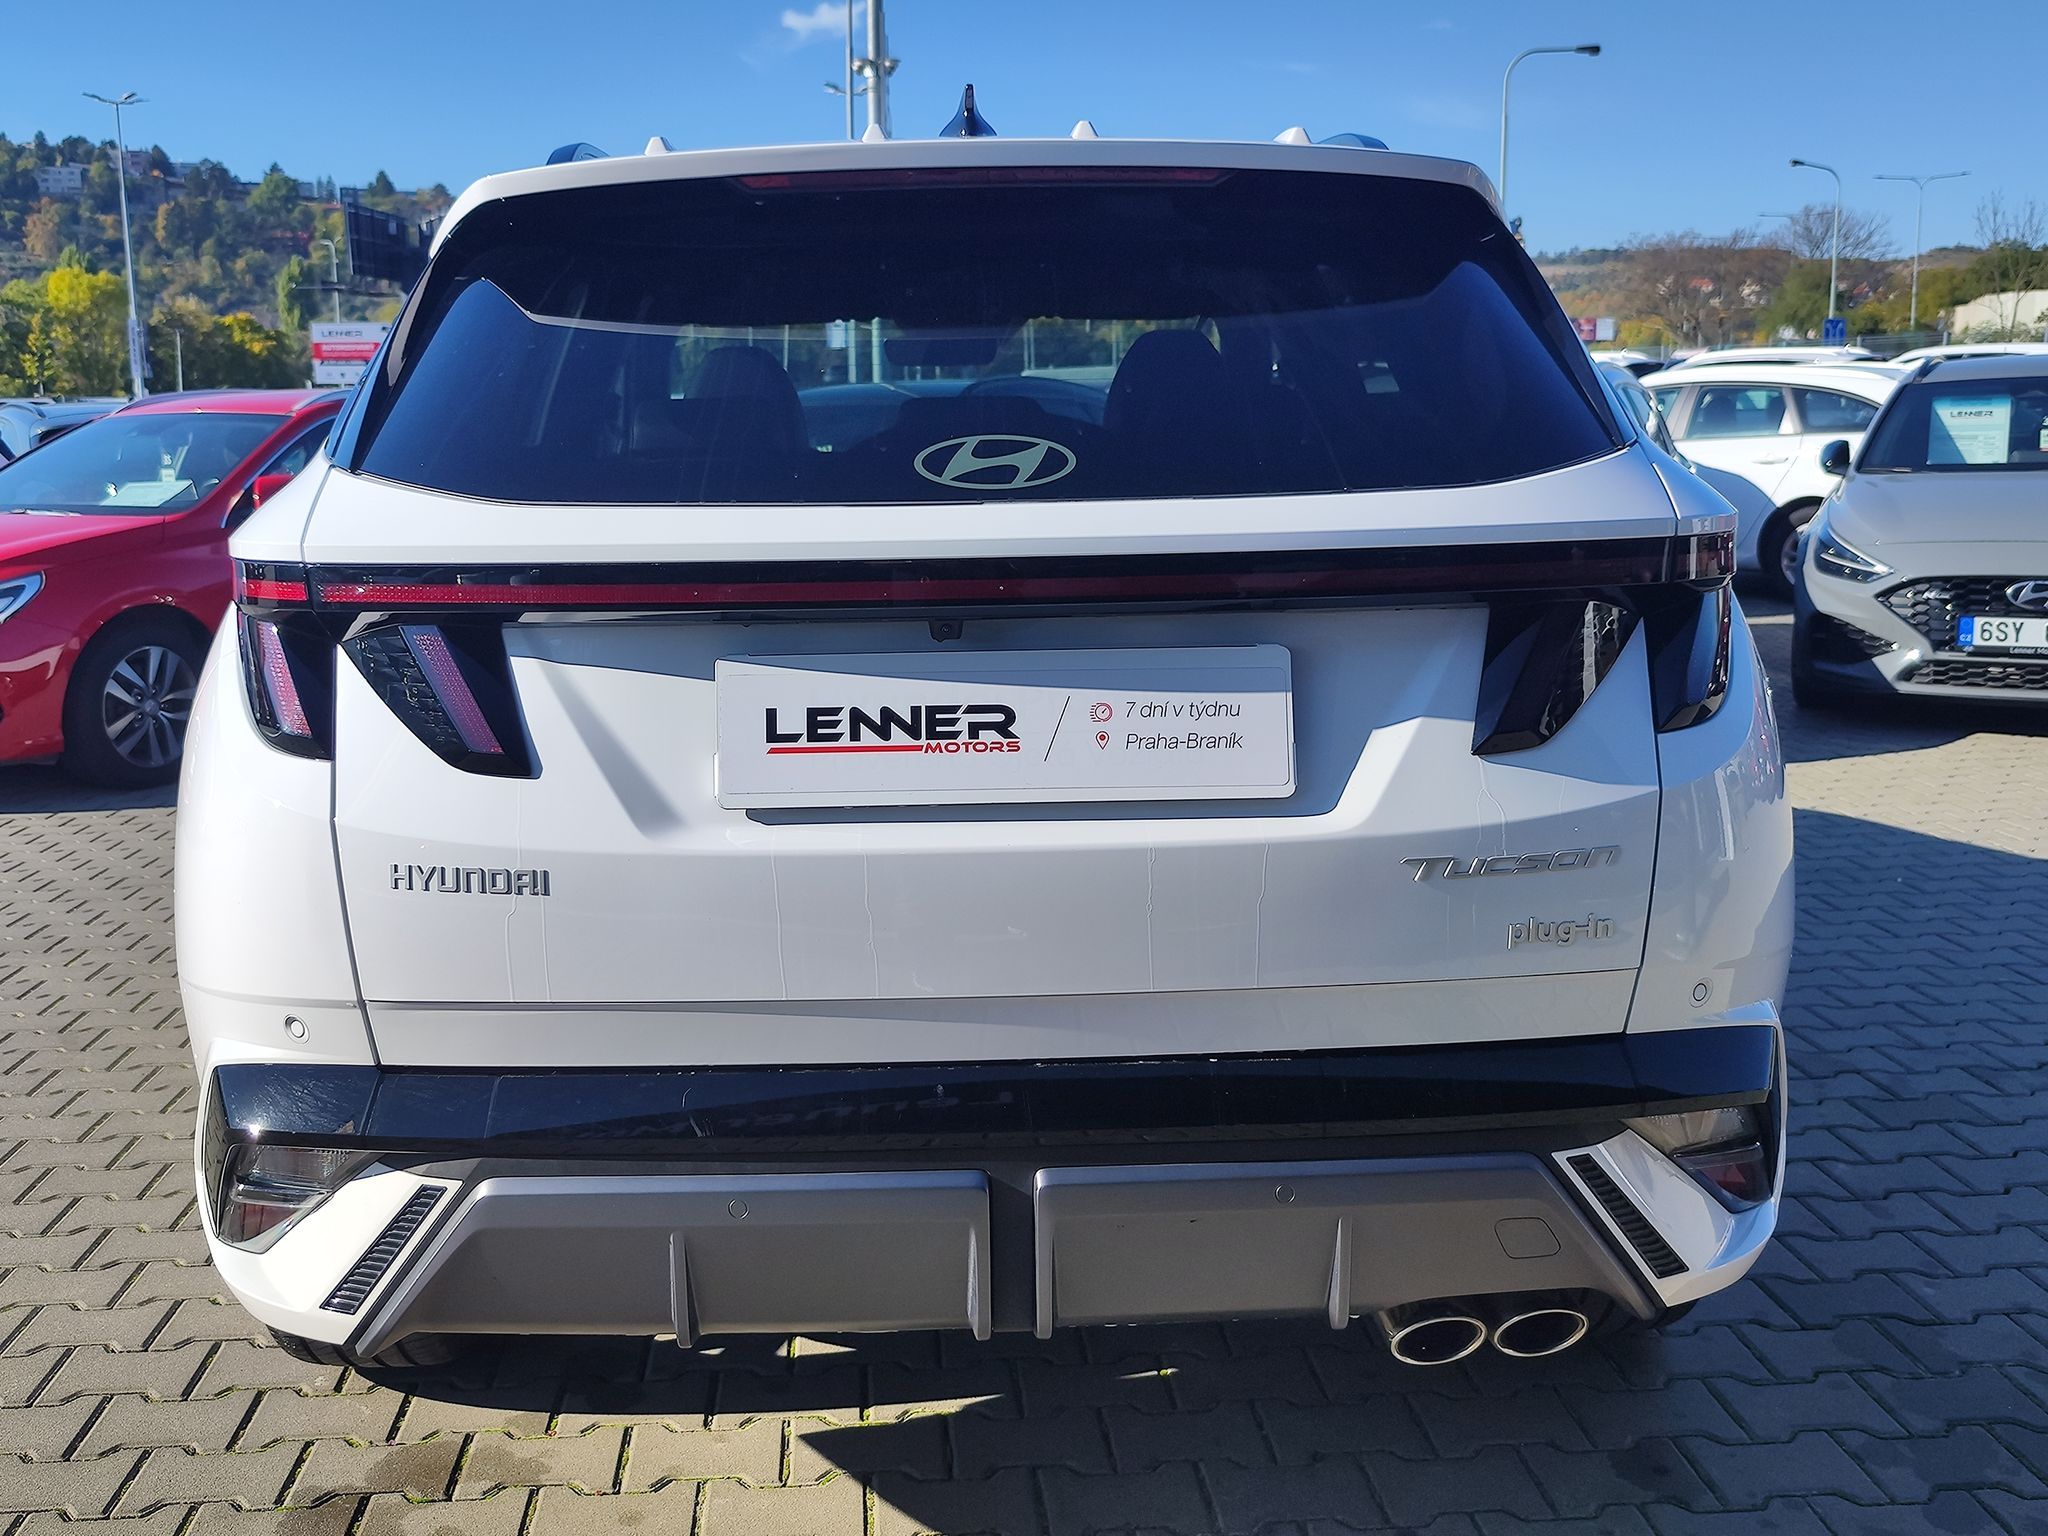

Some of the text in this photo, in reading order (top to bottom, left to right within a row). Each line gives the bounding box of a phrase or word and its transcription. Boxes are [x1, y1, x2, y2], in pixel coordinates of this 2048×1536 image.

[1950, 410, 1993, 418] LENNER
[1980, 621, 2025, 643] 6SY
[1125, 700, 1241, 721] 7 dní v týdnu
[765, 704, 1021, 744] LENNER
[923, 740, 1021, 754] MOTORS
[1125, 732, 1244, 750] Praha-Braník
[390, 863, 551, 897] HYUNDAI
[1506, 912, 1617, 951] plug-in
